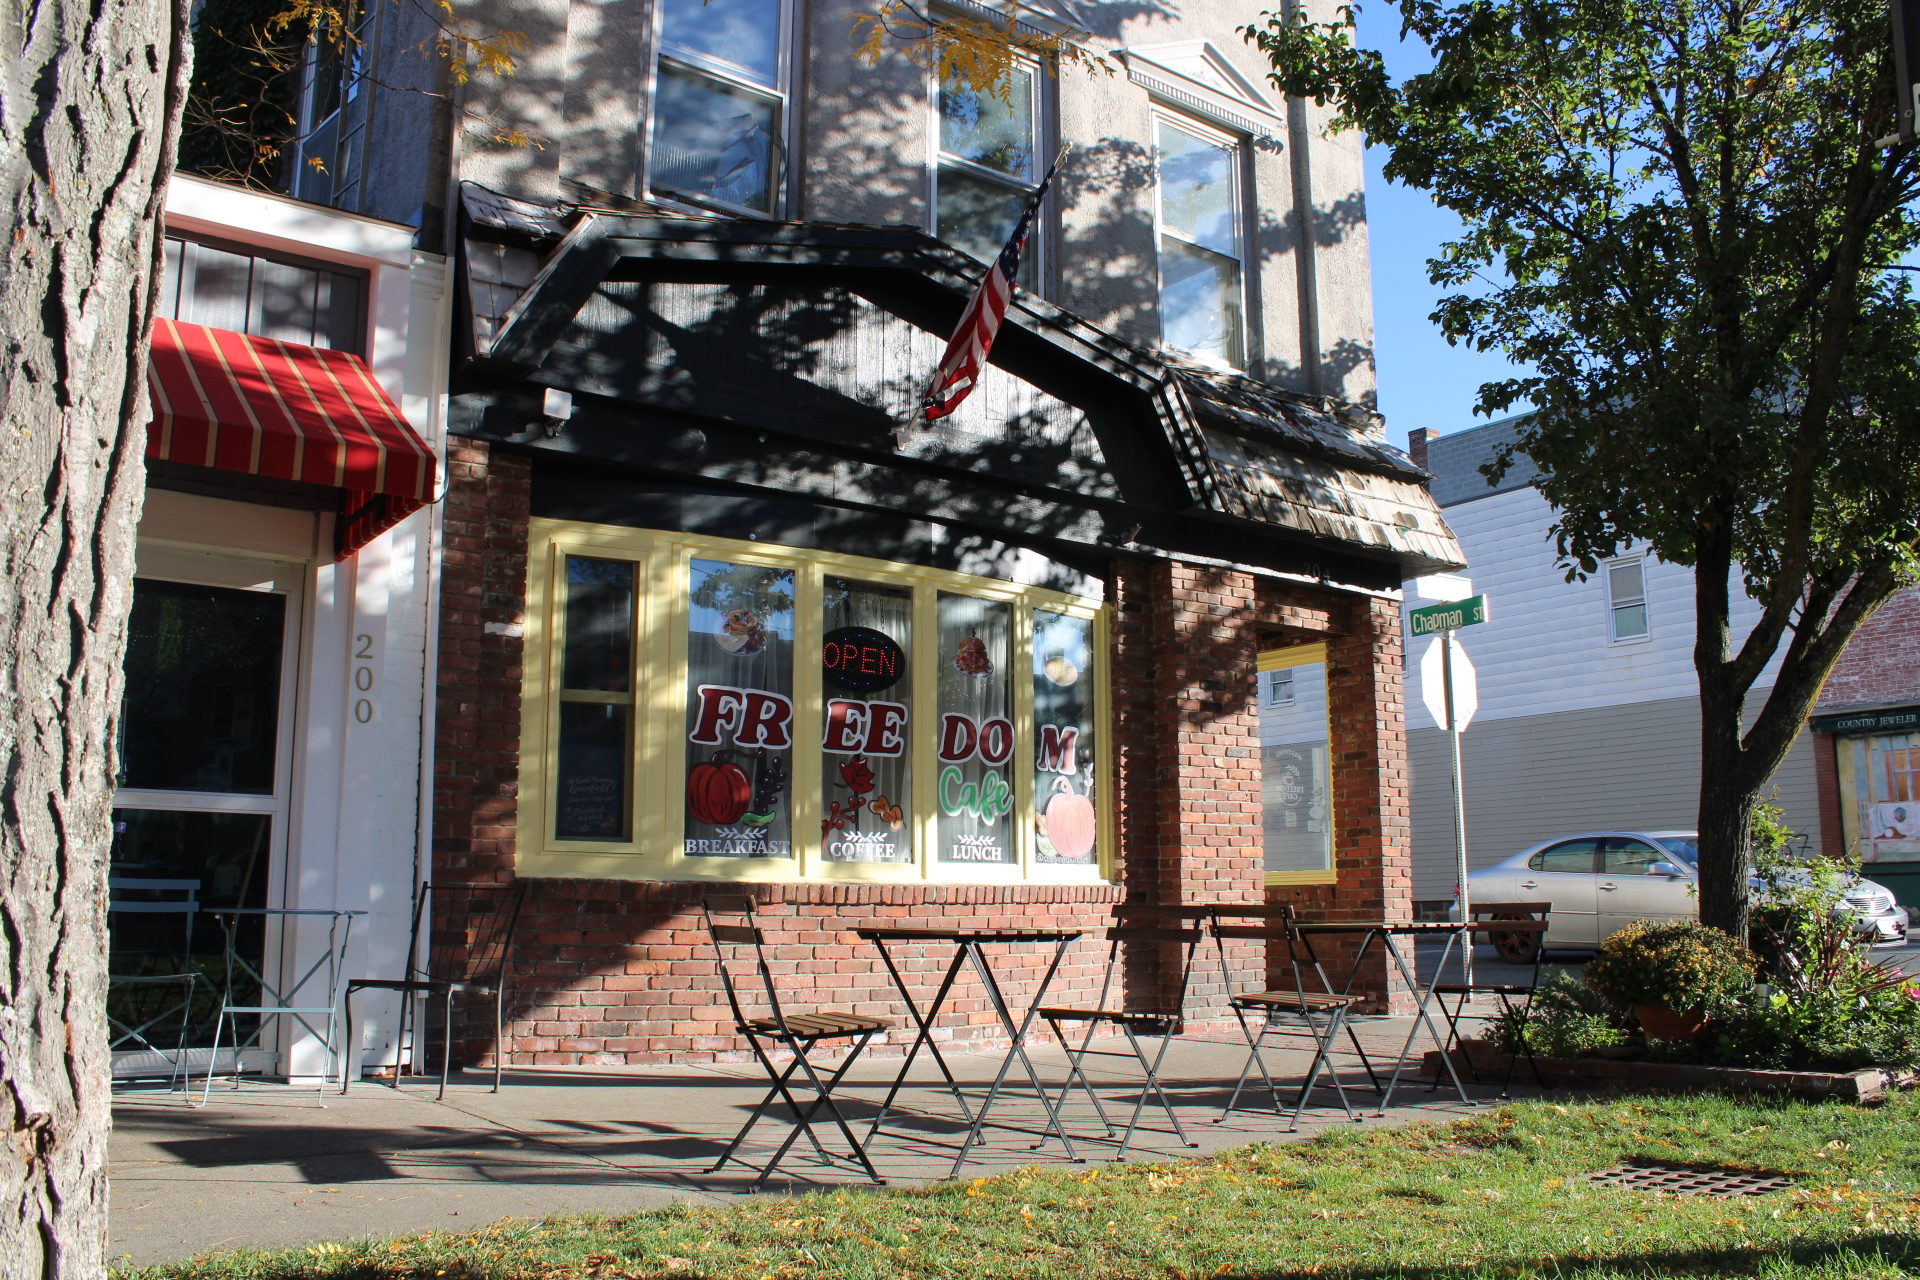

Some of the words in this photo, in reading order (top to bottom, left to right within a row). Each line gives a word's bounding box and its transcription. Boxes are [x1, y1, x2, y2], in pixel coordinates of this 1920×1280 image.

[1412, 609, 1463, 633] Chapman
[822, 641, 897, 677] OPEN
[354, 633, 374, 724] 200
[1837, 717, 1877, 729] COUNTRY
[1879, 714, 1917, 726] JEWELER
[938, 765, 1015, 827] Cafe
[685, 838, 791, 856] BREAKFAST
[829, 841, 896, 859] COFFEE
[952, 844, 1002, 862] LUNCH
